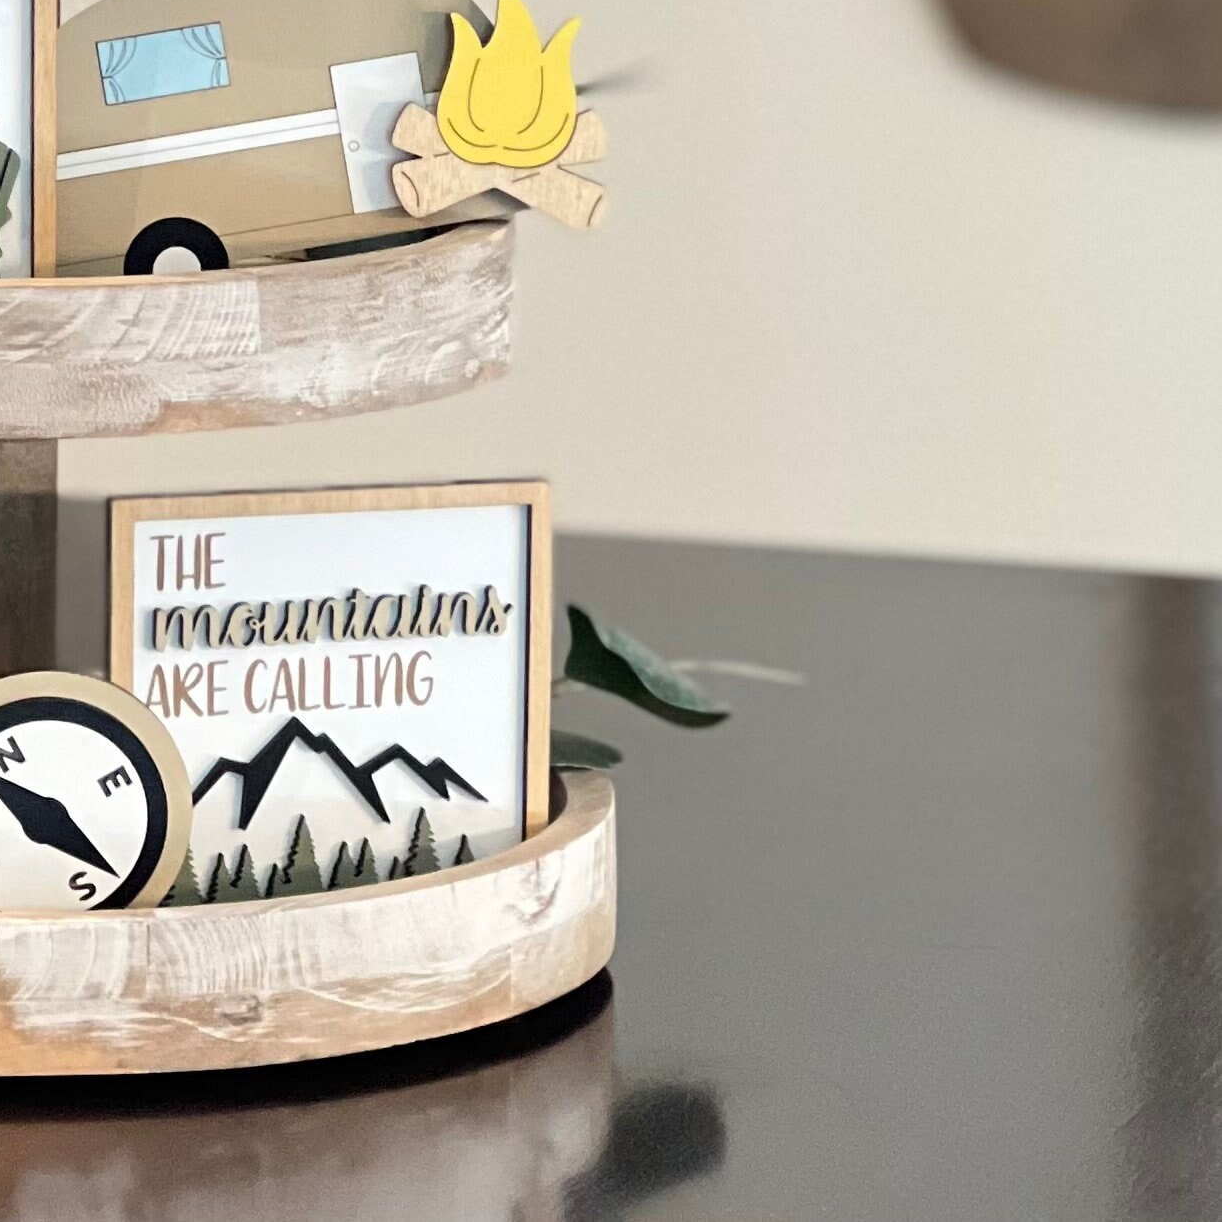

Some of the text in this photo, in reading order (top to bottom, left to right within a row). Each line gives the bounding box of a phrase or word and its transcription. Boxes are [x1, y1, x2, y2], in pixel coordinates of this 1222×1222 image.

[150, 532, 227, 591] THE
[150, 583, 514, 652] mountains
[145, 650, 434, 718] ARE CALLING
[97, 765, 133, 798] E
[68, 871, 97, 901] S
